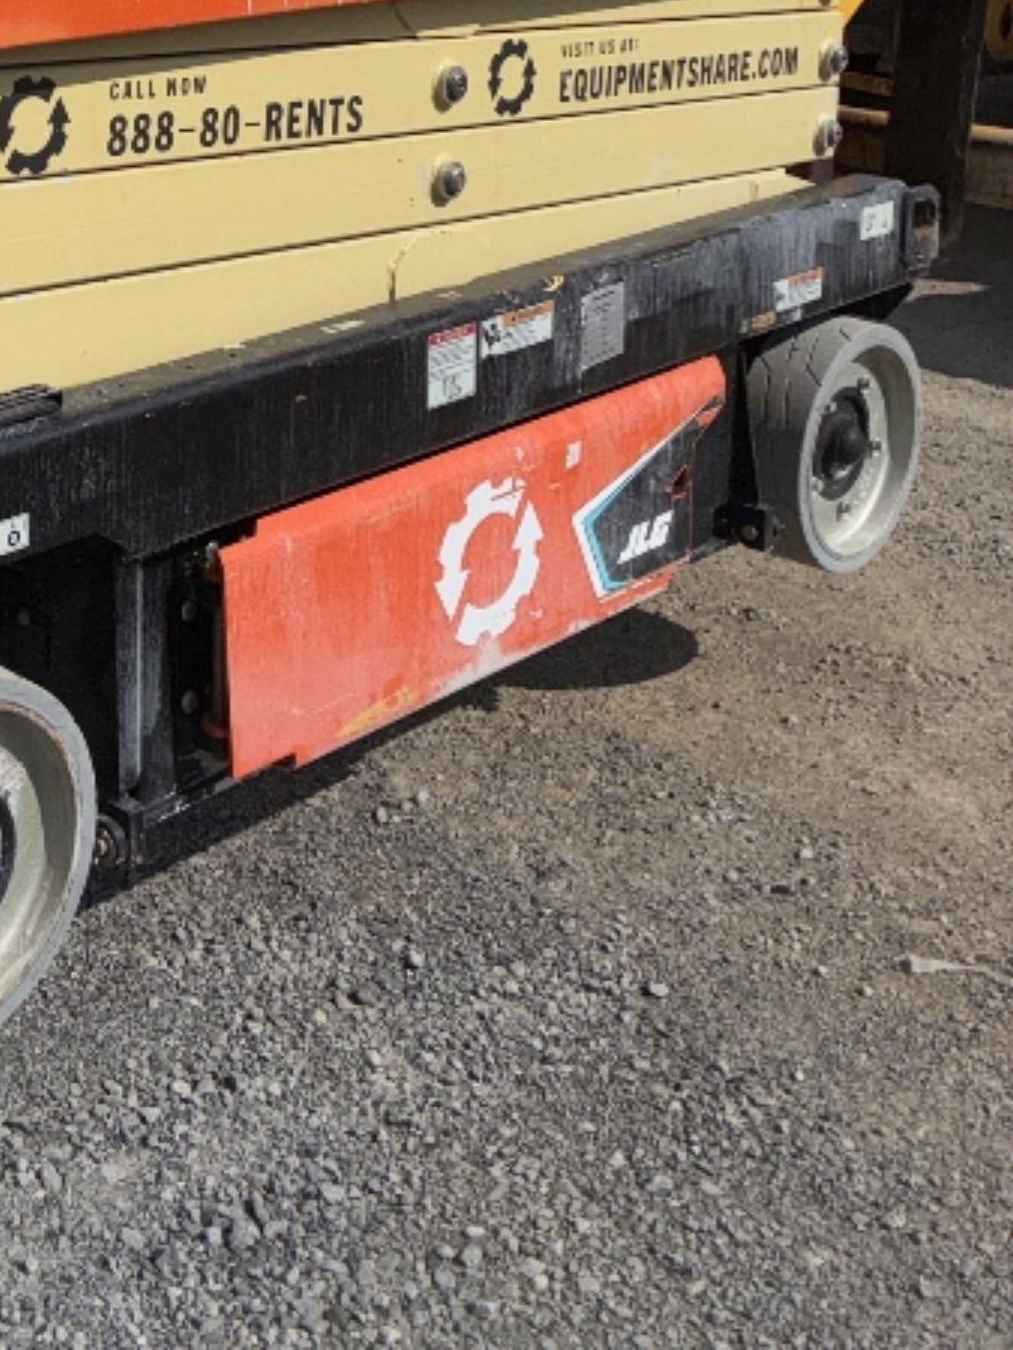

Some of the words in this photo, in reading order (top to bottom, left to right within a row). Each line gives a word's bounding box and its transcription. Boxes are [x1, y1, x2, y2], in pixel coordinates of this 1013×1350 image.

[559, 47, 799, 102] EQUIPMENTSHARE.COM
[561, 41, 594, 58] VISIT
[599, 39, 615, 55] US
[109, 79, 156, 100] CALL
[166, 74, 207, 96] NOW
[106, 96, 364, 157] 888-80-RENTS
[617, 509, 675, 564] JLG
